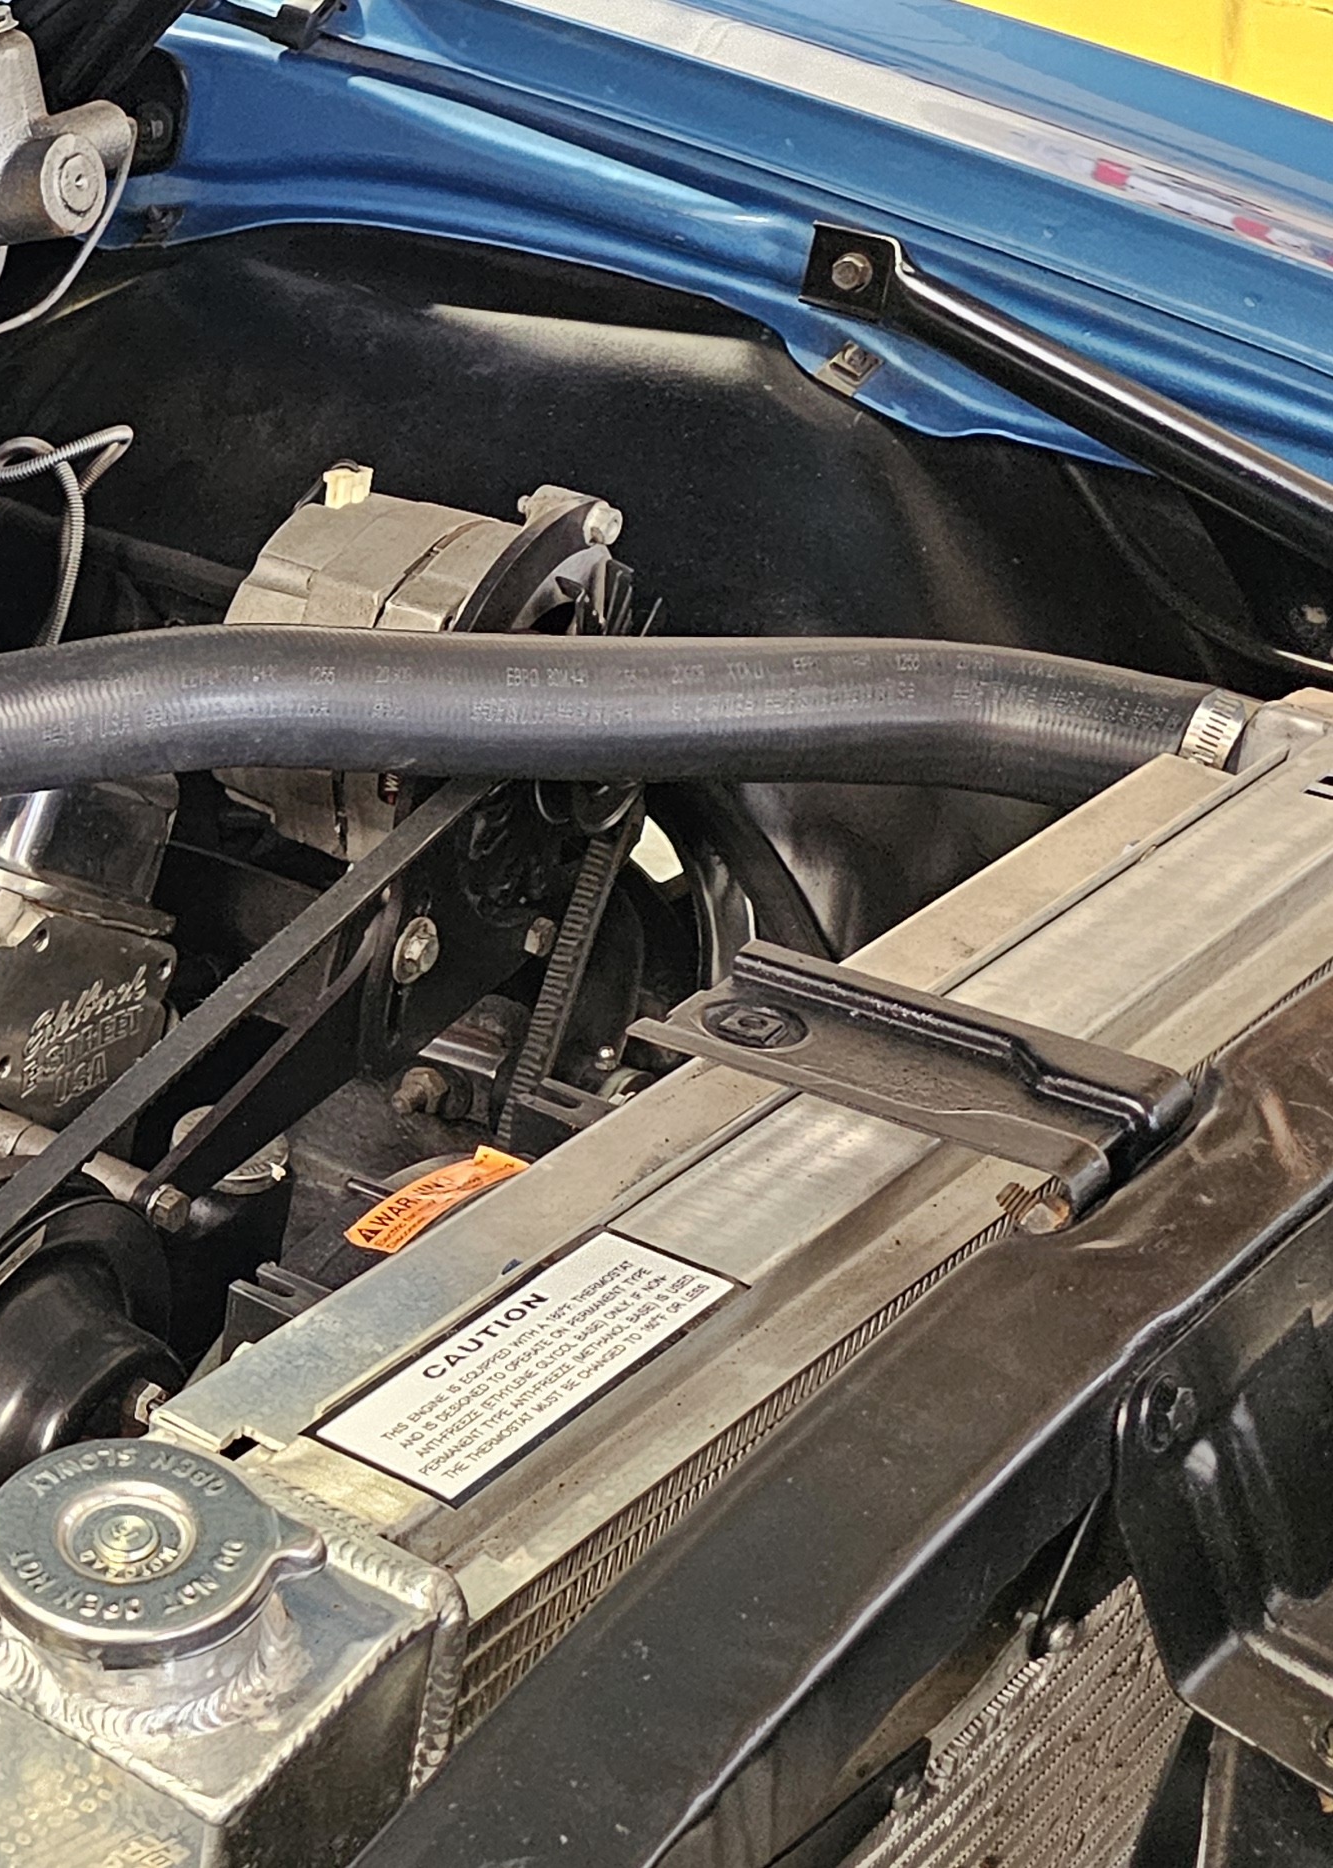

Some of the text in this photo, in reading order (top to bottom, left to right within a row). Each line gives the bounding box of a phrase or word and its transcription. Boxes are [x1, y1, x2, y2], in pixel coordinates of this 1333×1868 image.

[20, 1004, 144, 1098] E-STREET
[53, 1051, 108, 1107] USA
[380, 1422, 408, 1440] THIS
[406, 1393, 449, 1422] ENGINE
[445, 1384, 461, 1393] IS
[458, 1348, 511, 1384] EQUIPPED
[508, 1329, 539, 1347] WITH
[570, 1260, 633, 1302] THERMOSTAT
[399, 1267, 652, 1449] AND IS DESIGNED TO OPERATE ON PERMANENT TYPE
[415, 1408, 483, 1457] ANTI-FREEZE
[480, 1368, 538, 1410] (ETHYLENE
[535, 1342, 578, 1368] GLYCOL
[573, 1319, 608, 1341] BASE)
[629, 1291, 641, 1300] IF
[418, 1427, 483, 1475] PERMANENT
[480, 1407, 513, 1428] TYPE
[509, 1362, 575, 1409] ANTI-FREEZE
[571, 1324, 630, 1363] (METHANOL
[625, 1302, 660, 1323] BASE)
[654, 1293, 669, 1301] IS
[422, 1292, 548, 1378] CAUTION
[440, 1461, 469, 1478] THE
[464, 1411, 533, 1461] THERMOSTAT
[530, 1389, 563, 1412] MUST
[559, 1378, 581, 1391] BE
[576, 1344, 626, 1378] CHANGED
[622, 1332, 642, 1344] TO
[665, 1301, 686, 1313] OR
[680, 1283, 710, 1302] LESS
[26, 1448, 228, 1498] OPEN SLOWLY
[7, 1539, 245, 1622] DO NOT OPEN HOT
